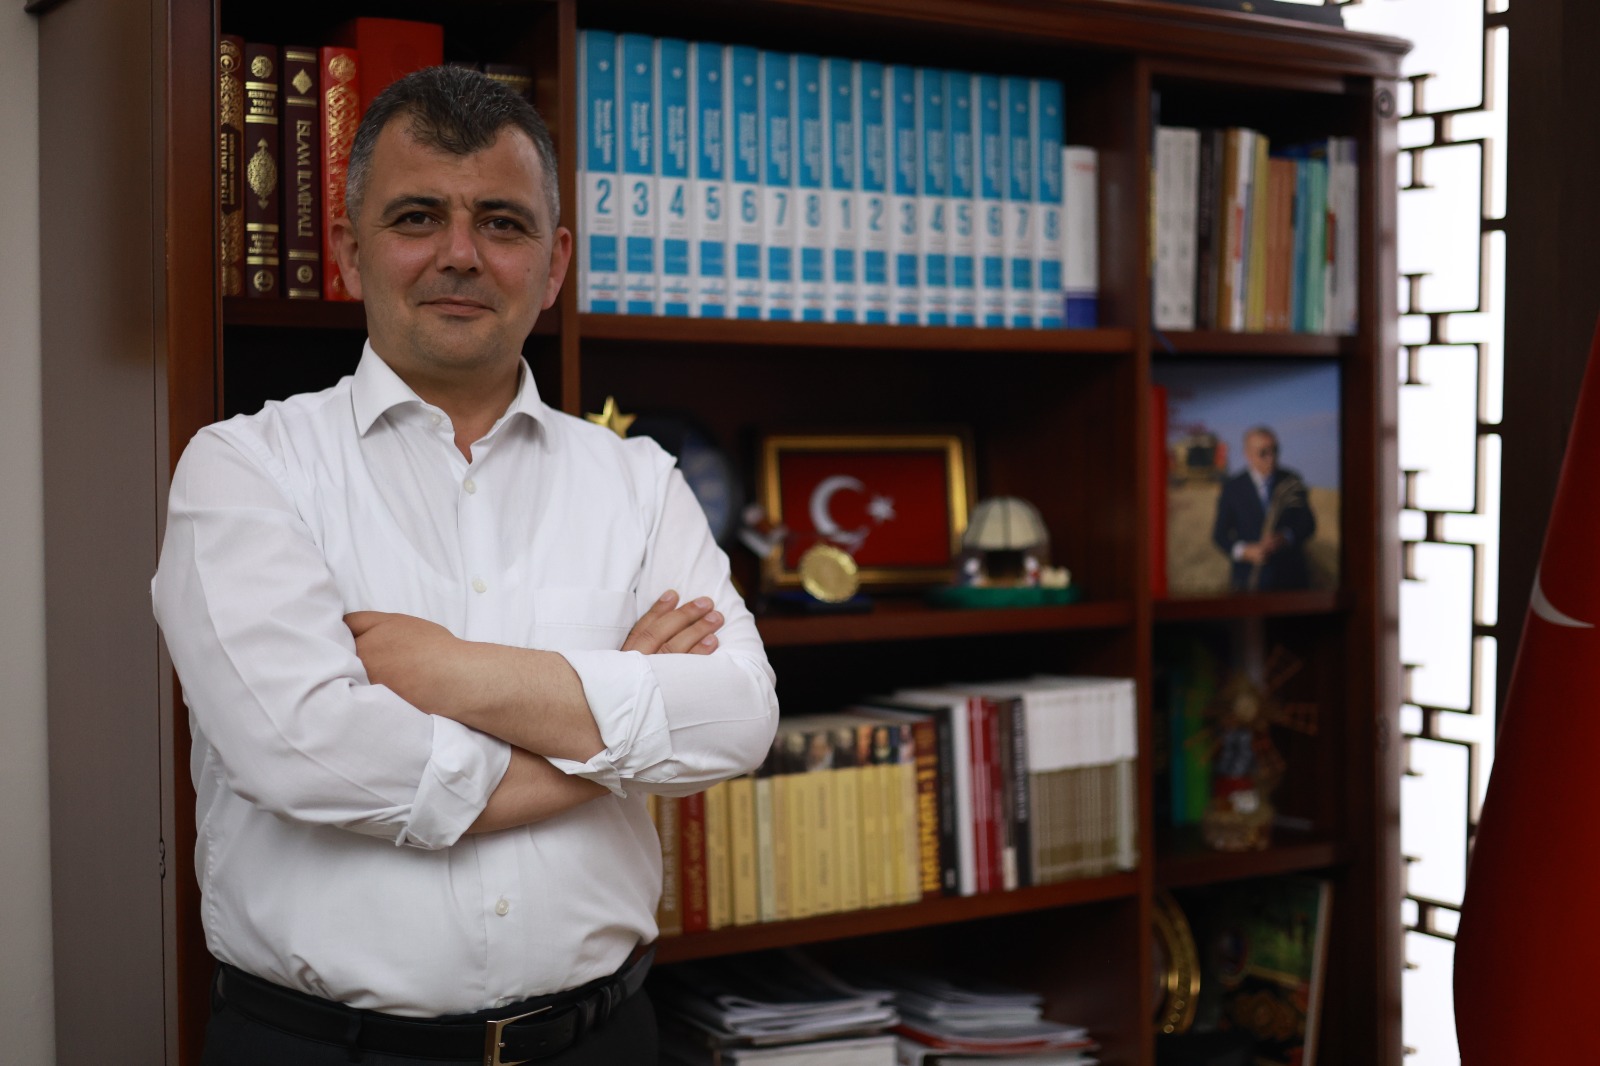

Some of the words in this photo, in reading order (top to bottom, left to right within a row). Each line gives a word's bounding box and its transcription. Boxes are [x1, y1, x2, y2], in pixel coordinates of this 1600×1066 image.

[595, 178, 612, 215] 2
[633, 181, 649, 217] 3
[669, 184, 685, 219] 4
[706, 186, 721, 221] 5
[741, 189, 757, 224] 6
[775, 193, 787, 227] 7
[806, 194, 821, 228] 8
[841, 198, 851, 231] 1
[870, 198, 884, 231] 2
[902, 202, 916, 236] 3
[931, 203, 945, 234] 4
[957, 204, 972, 237] 5
[987, 206, 1002, 237] 6
[1017, 207, 1029, 239] 7
[1044, 210, 1060, 241] 8
